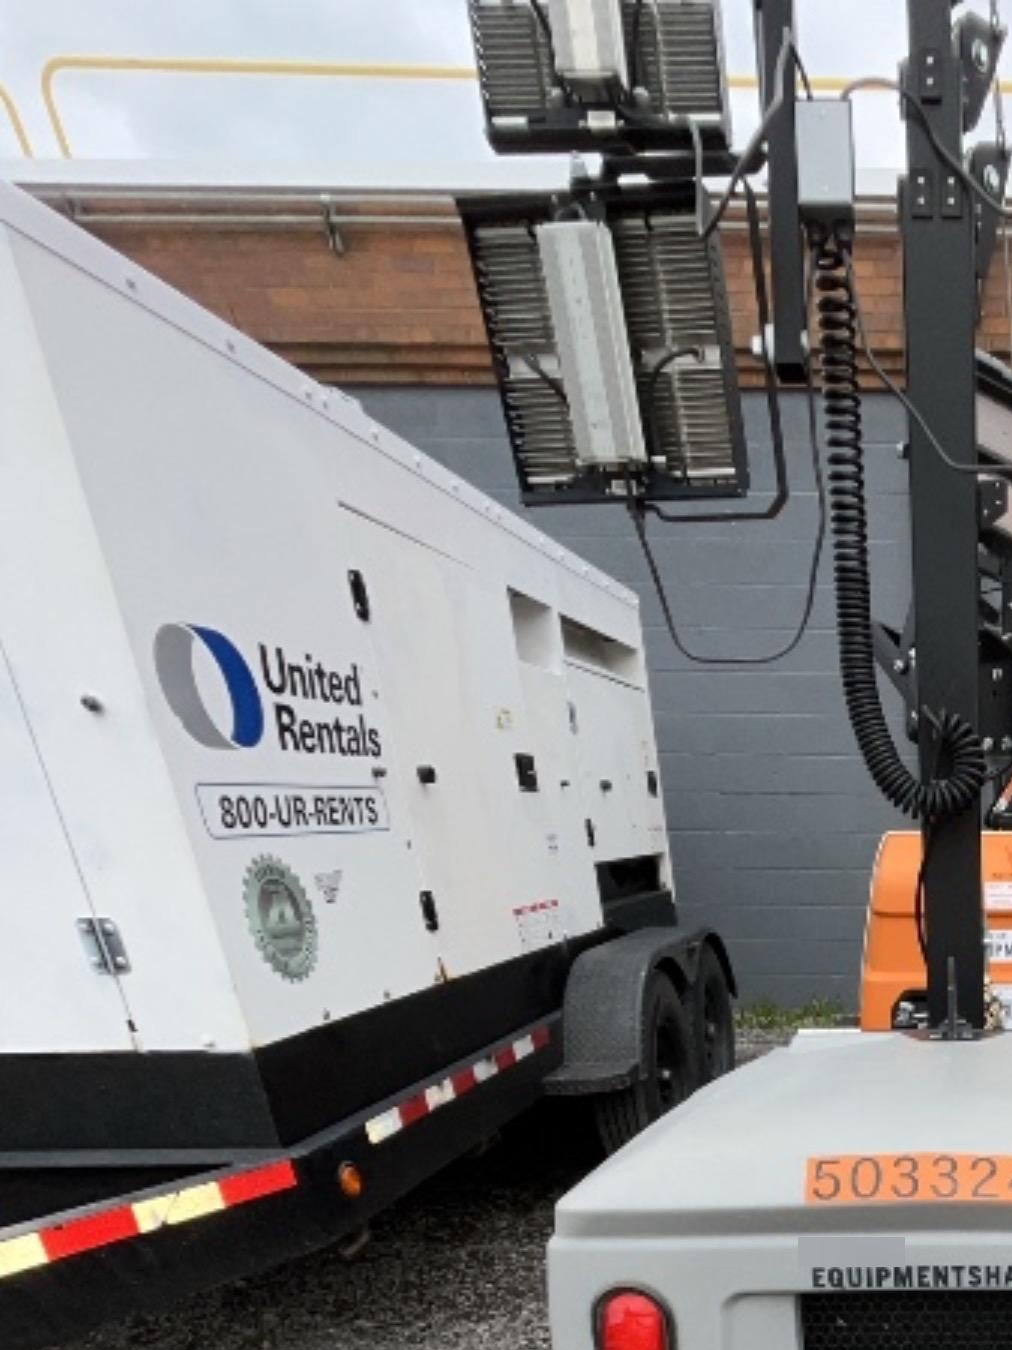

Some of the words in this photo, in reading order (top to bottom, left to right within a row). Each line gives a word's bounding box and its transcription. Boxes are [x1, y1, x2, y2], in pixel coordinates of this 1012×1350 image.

[258, 641, 362, 706] United
[274, 702, 382, 757] Rentals
[219, 795, 379, 829] 800-UR-RENTS
